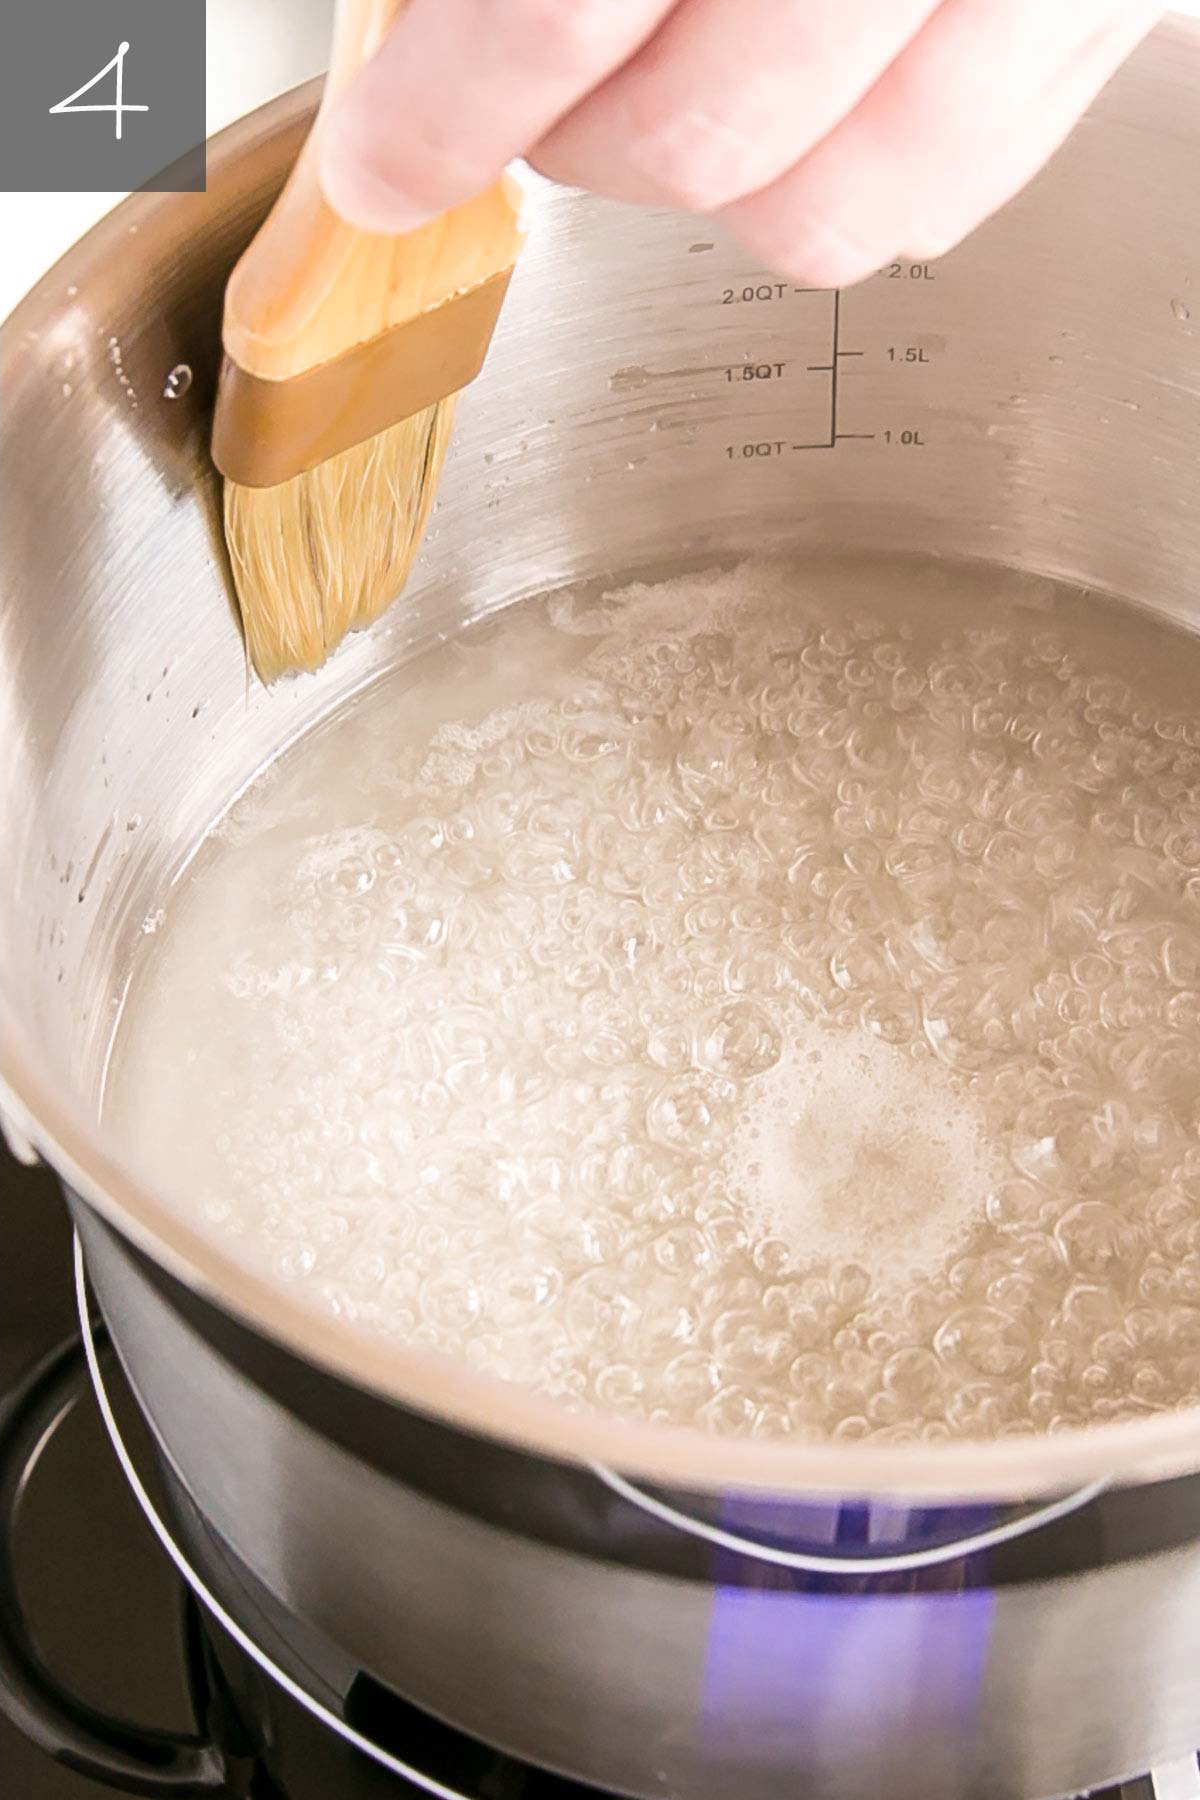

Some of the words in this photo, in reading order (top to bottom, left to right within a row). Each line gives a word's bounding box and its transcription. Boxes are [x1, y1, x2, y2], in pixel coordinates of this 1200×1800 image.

[889, 263, 935, 280] 2.0L
[722, 284, 788, 304] 2.0QT
[888, 348, 930, 363] 1.5L
[725, 363, 786, 382] 1.5QT
[884, 430, 925, 445] 1.0L
[726, 441, 787, 459] 1.0QT
